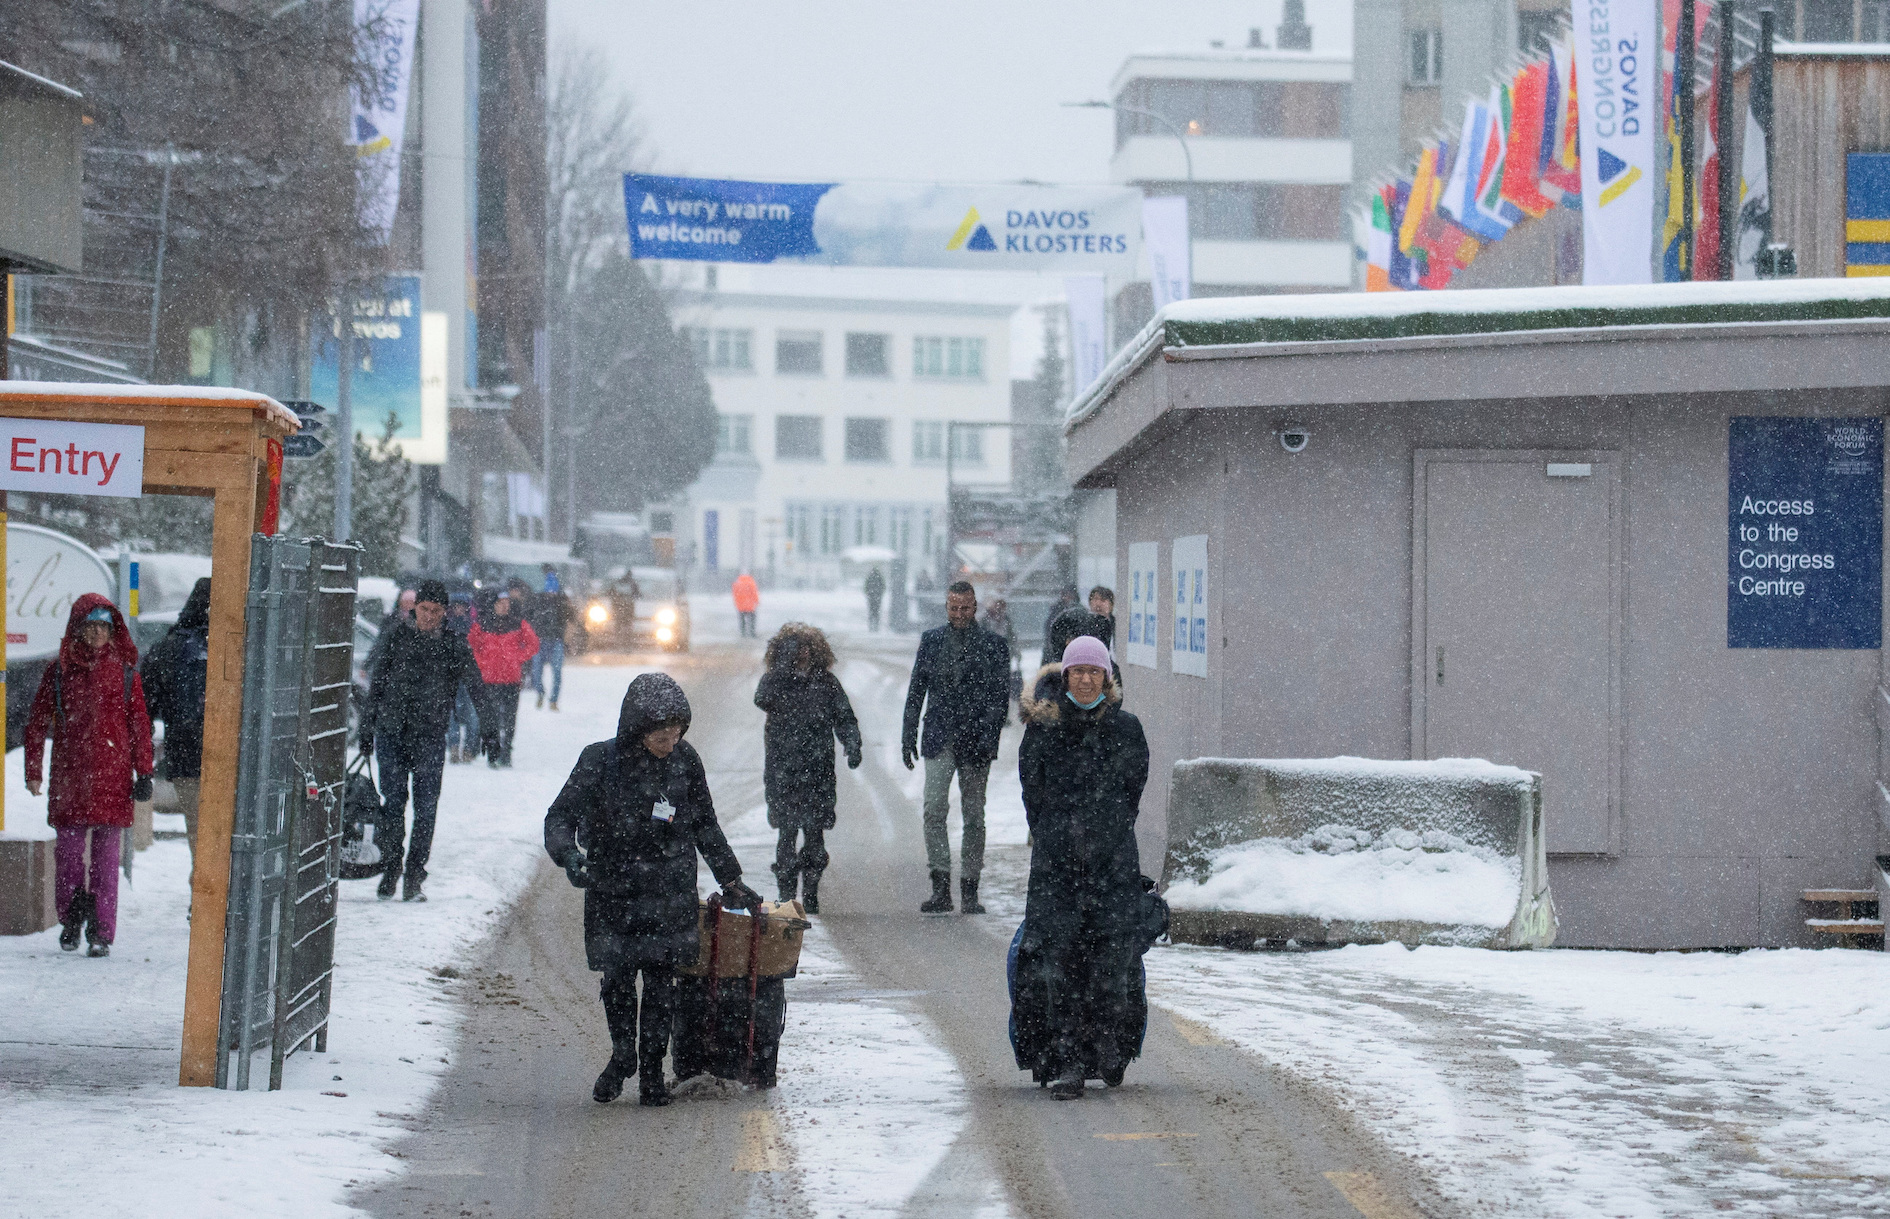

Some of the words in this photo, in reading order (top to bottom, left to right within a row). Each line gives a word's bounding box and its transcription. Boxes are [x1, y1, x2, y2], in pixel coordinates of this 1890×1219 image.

[640, 193, 660, 215] A
[666, 199, 719, 223] very
[724, 202, 792, 222] warm
[1006, 210, 1090, 229] DAVOS
[637, 222, 743, 245] welcome
[1006, 234, 1127, 253] KLOSTERS
[10, 436, 121, 486] Entry
[1740, 495, 1814, 515] Access
[1740, 523, 1759, 541] to
[1768, 522, 1799, 541] the
[1739, 549, 1835, 573] Congress
[1739, 576, 1805, 596] Centre
